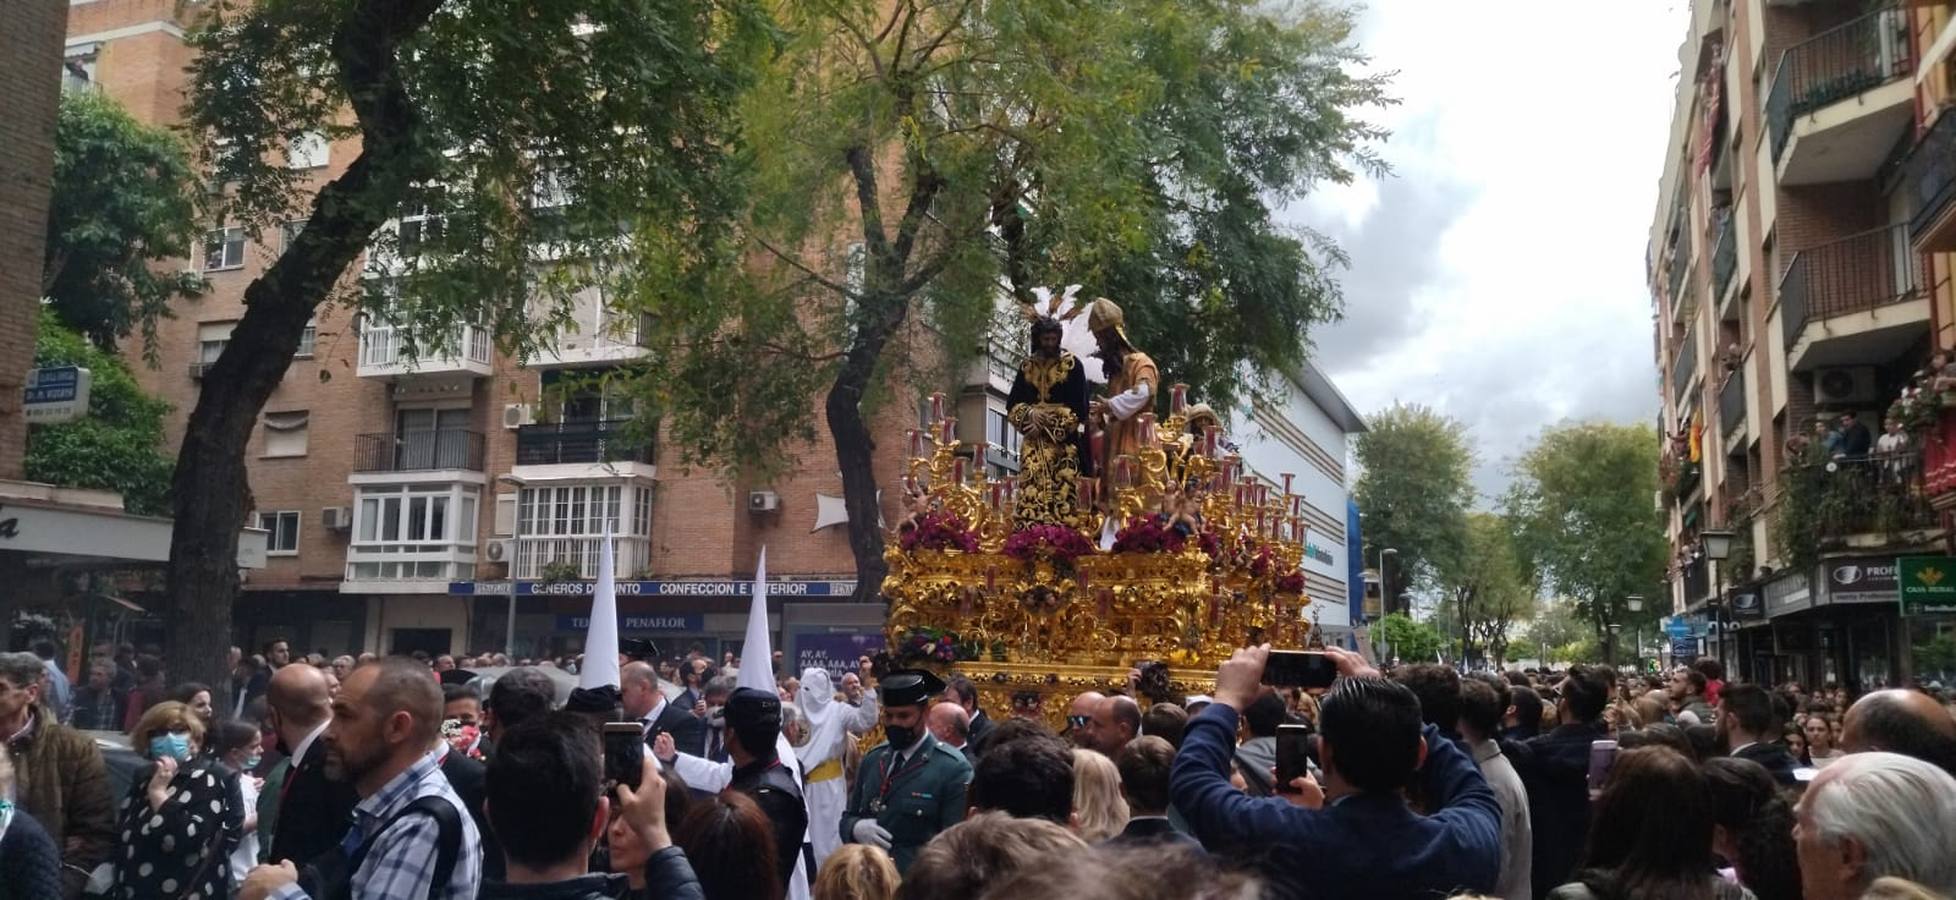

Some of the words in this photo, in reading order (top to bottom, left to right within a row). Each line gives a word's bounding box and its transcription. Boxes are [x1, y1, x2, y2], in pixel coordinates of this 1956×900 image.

[659, 583, 734, 594] CONFECCION
[739, 583, 748, 594] E
[752, 583, 807, 594] ITERIOR
